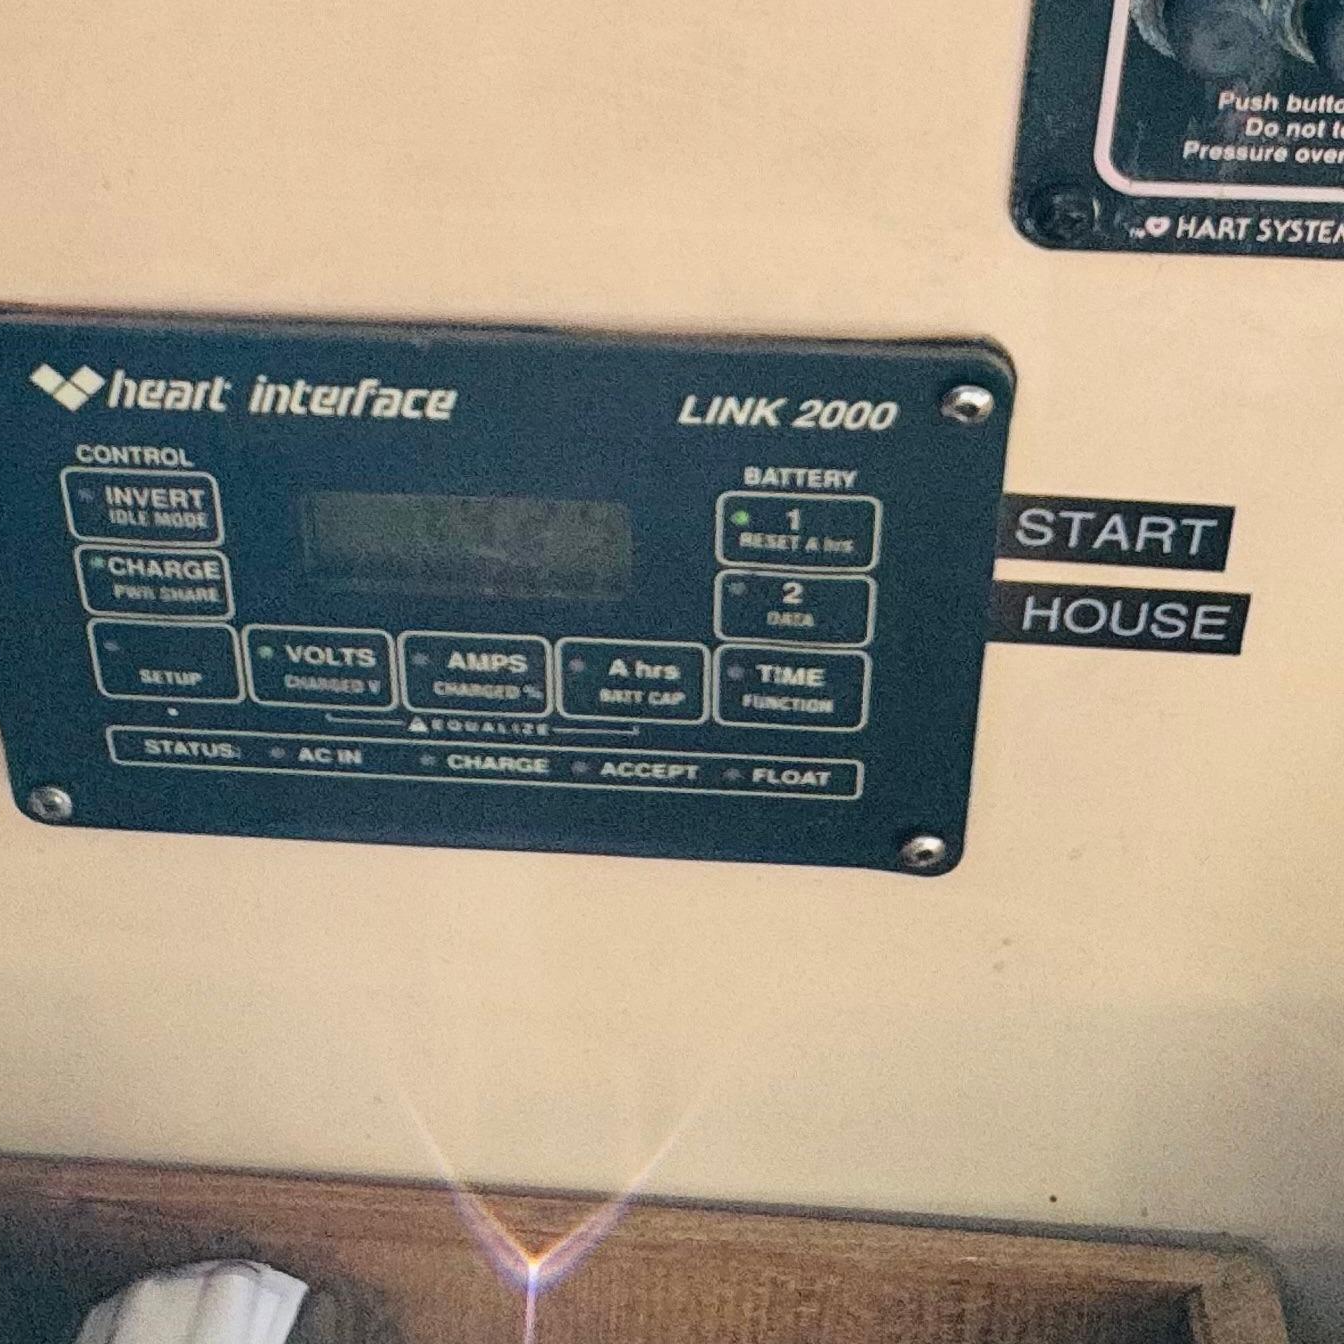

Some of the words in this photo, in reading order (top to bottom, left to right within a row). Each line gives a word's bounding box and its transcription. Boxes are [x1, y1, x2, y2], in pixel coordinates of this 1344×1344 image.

[1218, 89, 1279, 112] Push
[1245, 116, 1279, 137] Do
[1286, 120, 1326, 139] not
[1182, 139, 1288, 163] Pressure
[1176, 215, 1253, 241] HART
[107, 368, 229, 413] heart
[248, 374, 458, 421] interface
[678, 394, 785, 428] LINK
[792, 398, 901, 432] 2000
[76, 444, 195, 468] CONTROL
[743, 466, 858, 489] BATTERY
[106, 486, 205, 510] INVERT
[109, 508, 149, 527] IDLE
[155, 511, 209, 531] MODE
[786, 508, 801, 531] 1
[1013, 505, 1220, 558] START
[107, 556, 222, 581] CHARGE
[782, 582, 804, 605] 2
[1021, 594, 1235, 645] HOUSE
[284, 644, 377, 668] VOLTS
[447, 650, 528, 674] AMPS
[138, 668, 203, 687] SETUP
[608, 658, 632, 678] A
[635, 660, 681, 680] hrs
[755, 664, 827, 687] TIME
[298, 747, 334, 764] AC
[337, 748, 363, 766] IN
[447, 753, 550, 774] CHARGE
[600, 760, 699, 781] ACCEPT
[752, 767, 832, 787] FLOAT
